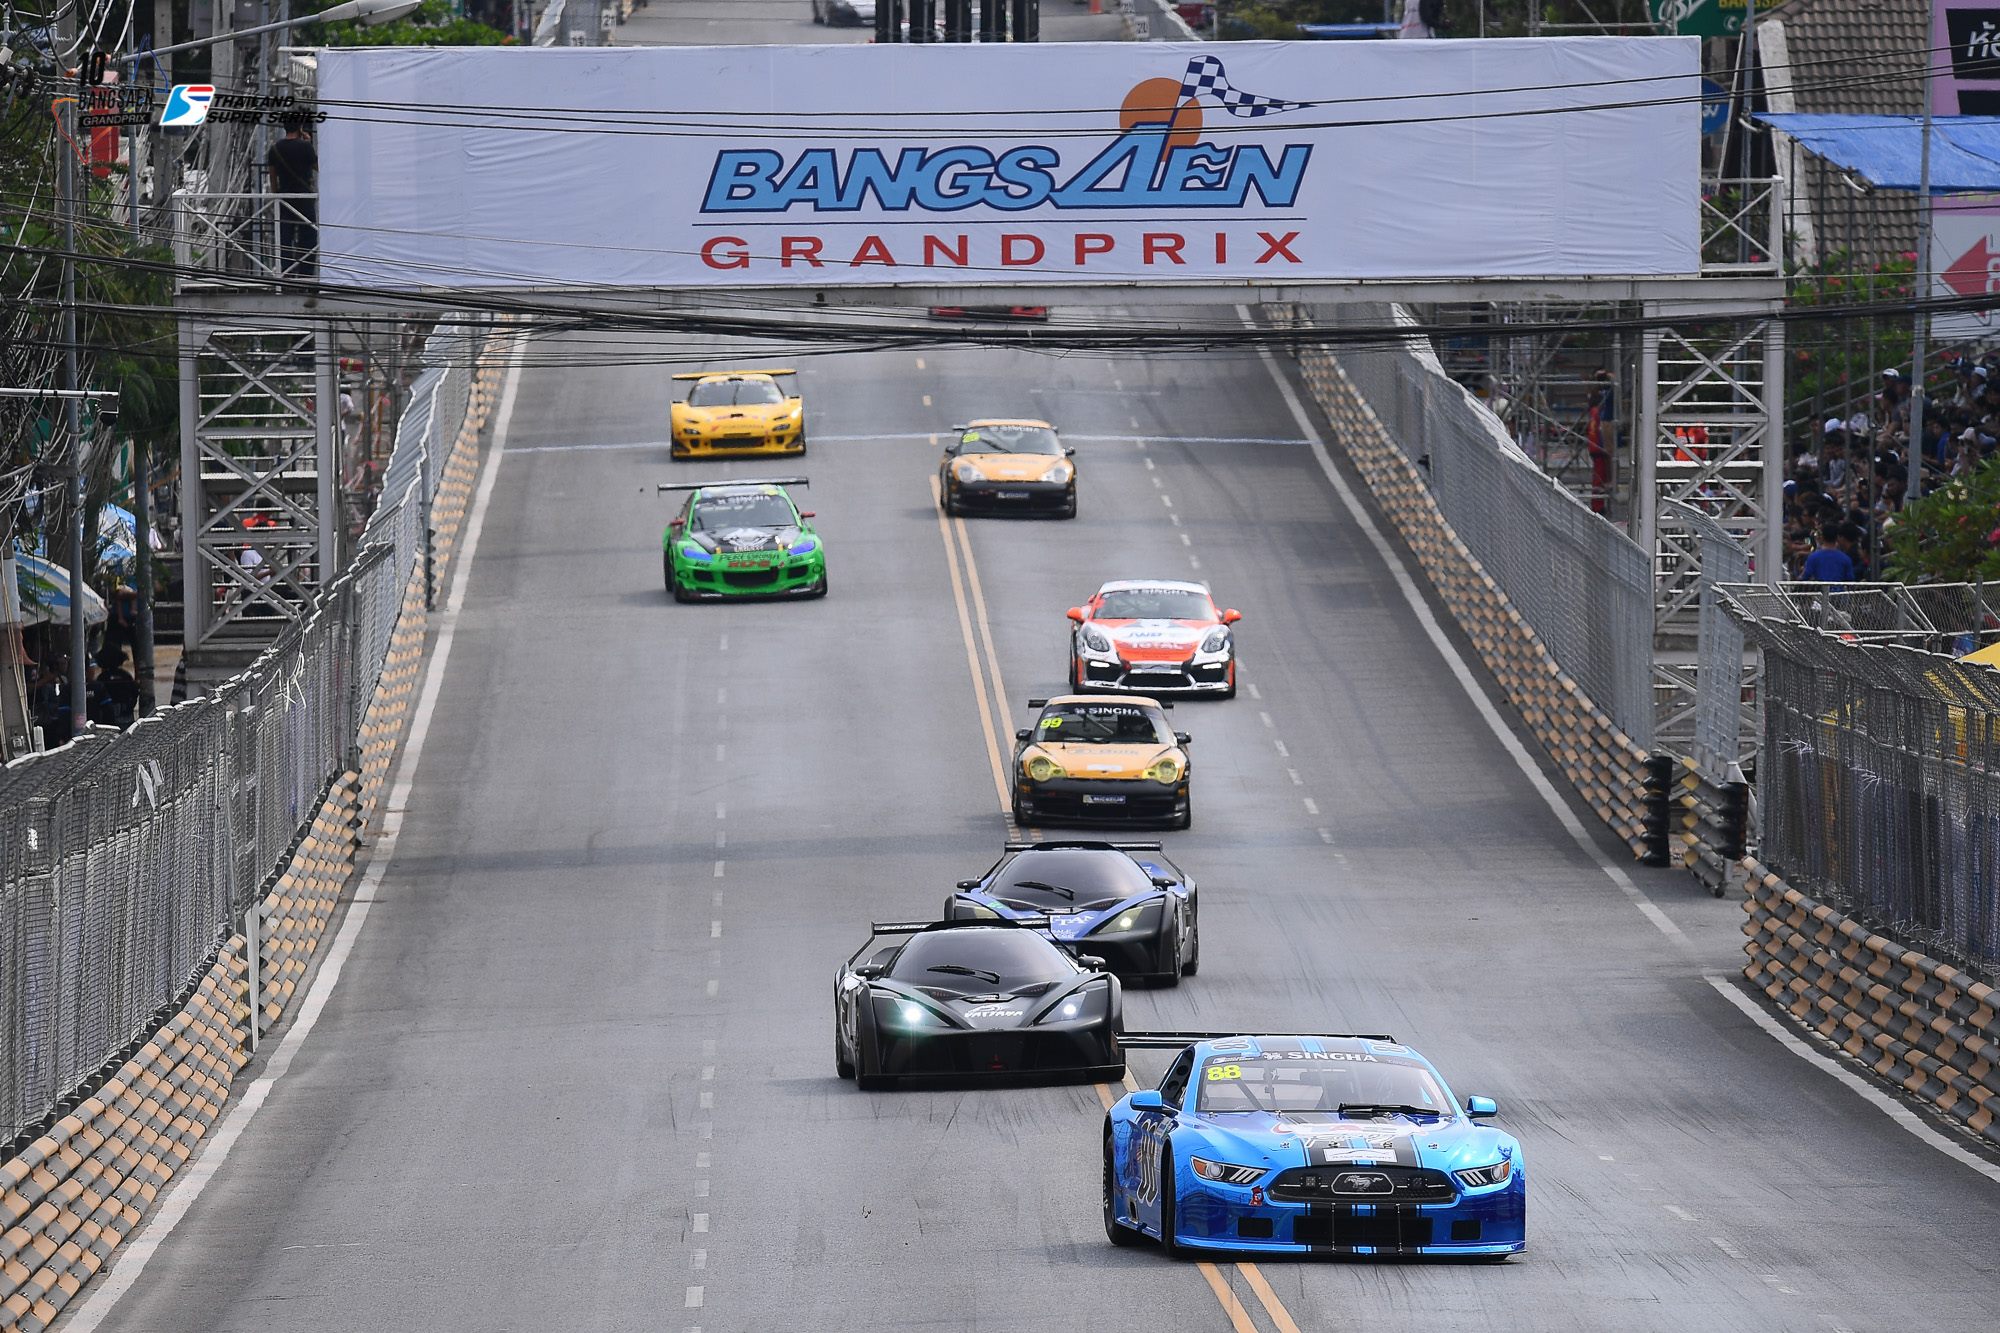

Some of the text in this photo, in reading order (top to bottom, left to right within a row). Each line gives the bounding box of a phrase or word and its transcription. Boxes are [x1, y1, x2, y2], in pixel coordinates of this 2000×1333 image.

[699, 120, 1314, 213] BANGSAEN
[1088, 707, 1141, 716] SINGHA
[1040, 717, 1064, 730] 99
[1286, 1051, 1379, 1063] SINGHA
[1207, 1064, 1242, 1081] 88
